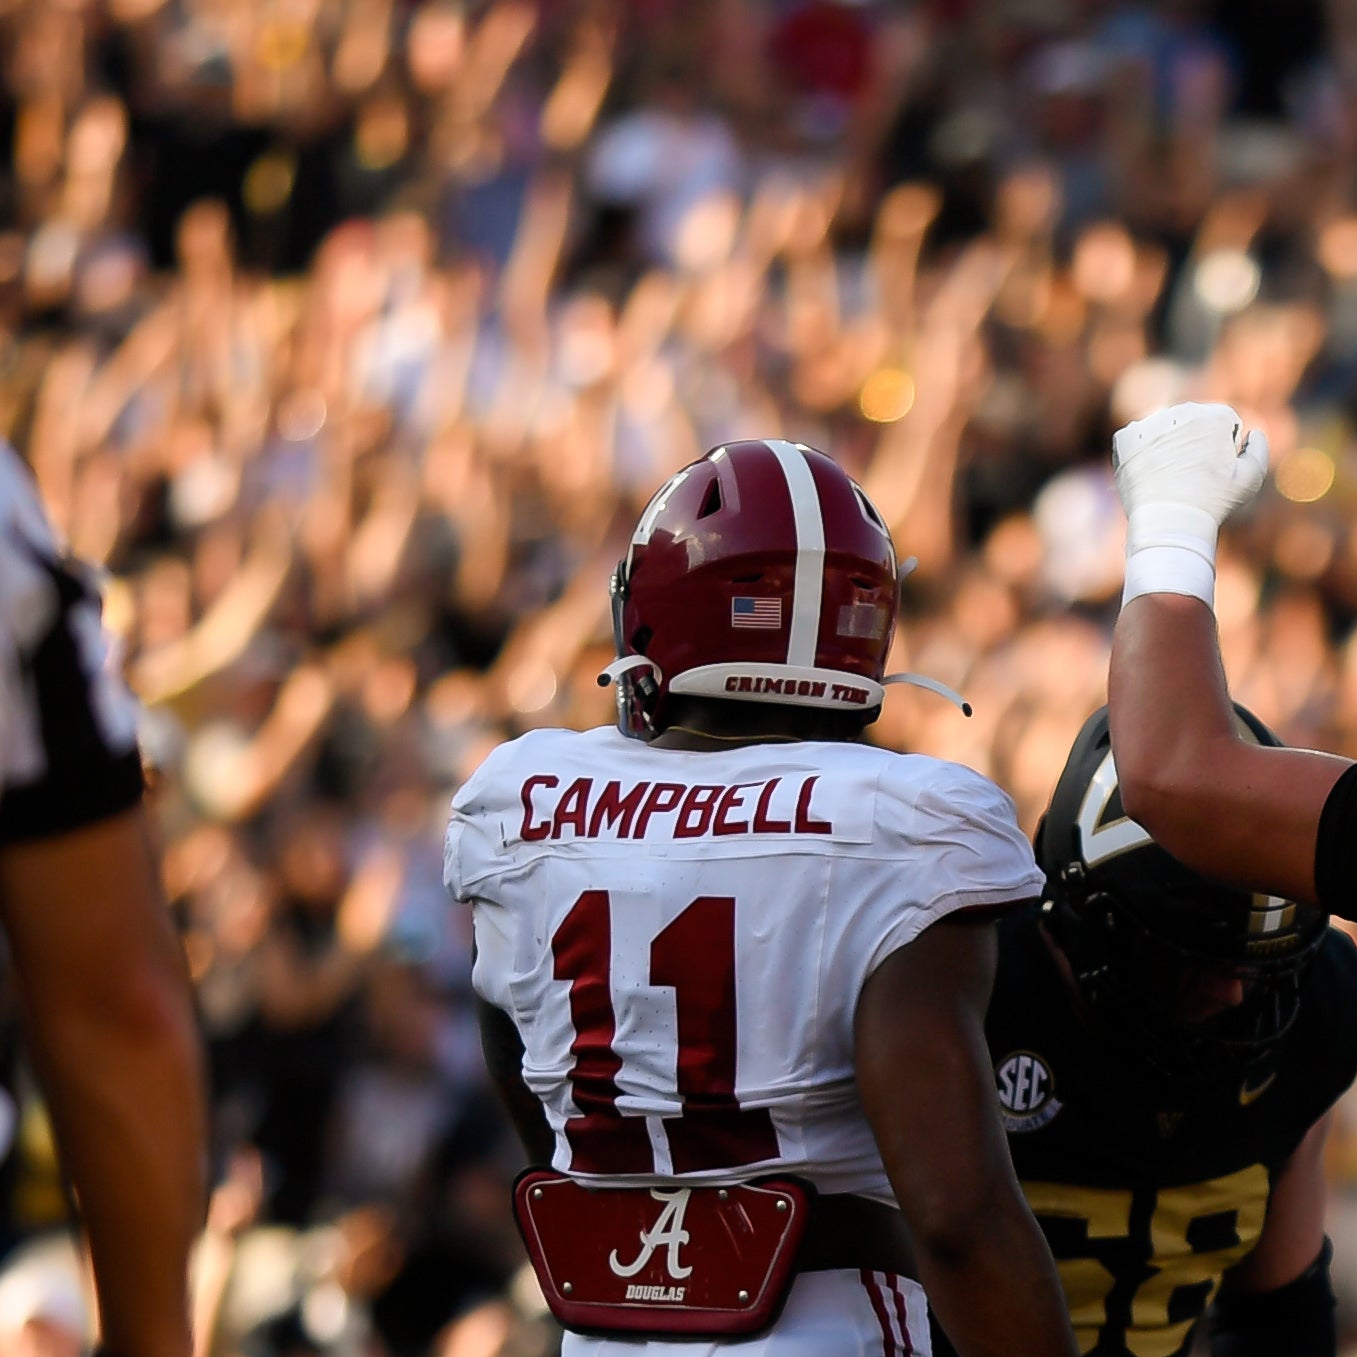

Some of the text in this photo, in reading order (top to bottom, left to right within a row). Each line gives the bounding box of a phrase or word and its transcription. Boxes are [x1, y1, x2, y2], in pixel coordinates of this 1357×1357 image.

[725, 676, 870, 704] CRIMSON TIDE
[520, 774, 833, 842] CAMPBELL
[552, 889, 782, 1175] 11
[999, 1055, 1049, 1112] SEC
[609, 1186, 694, 1279] A
[625, 1285, 686, 1302] DOUGLAS
